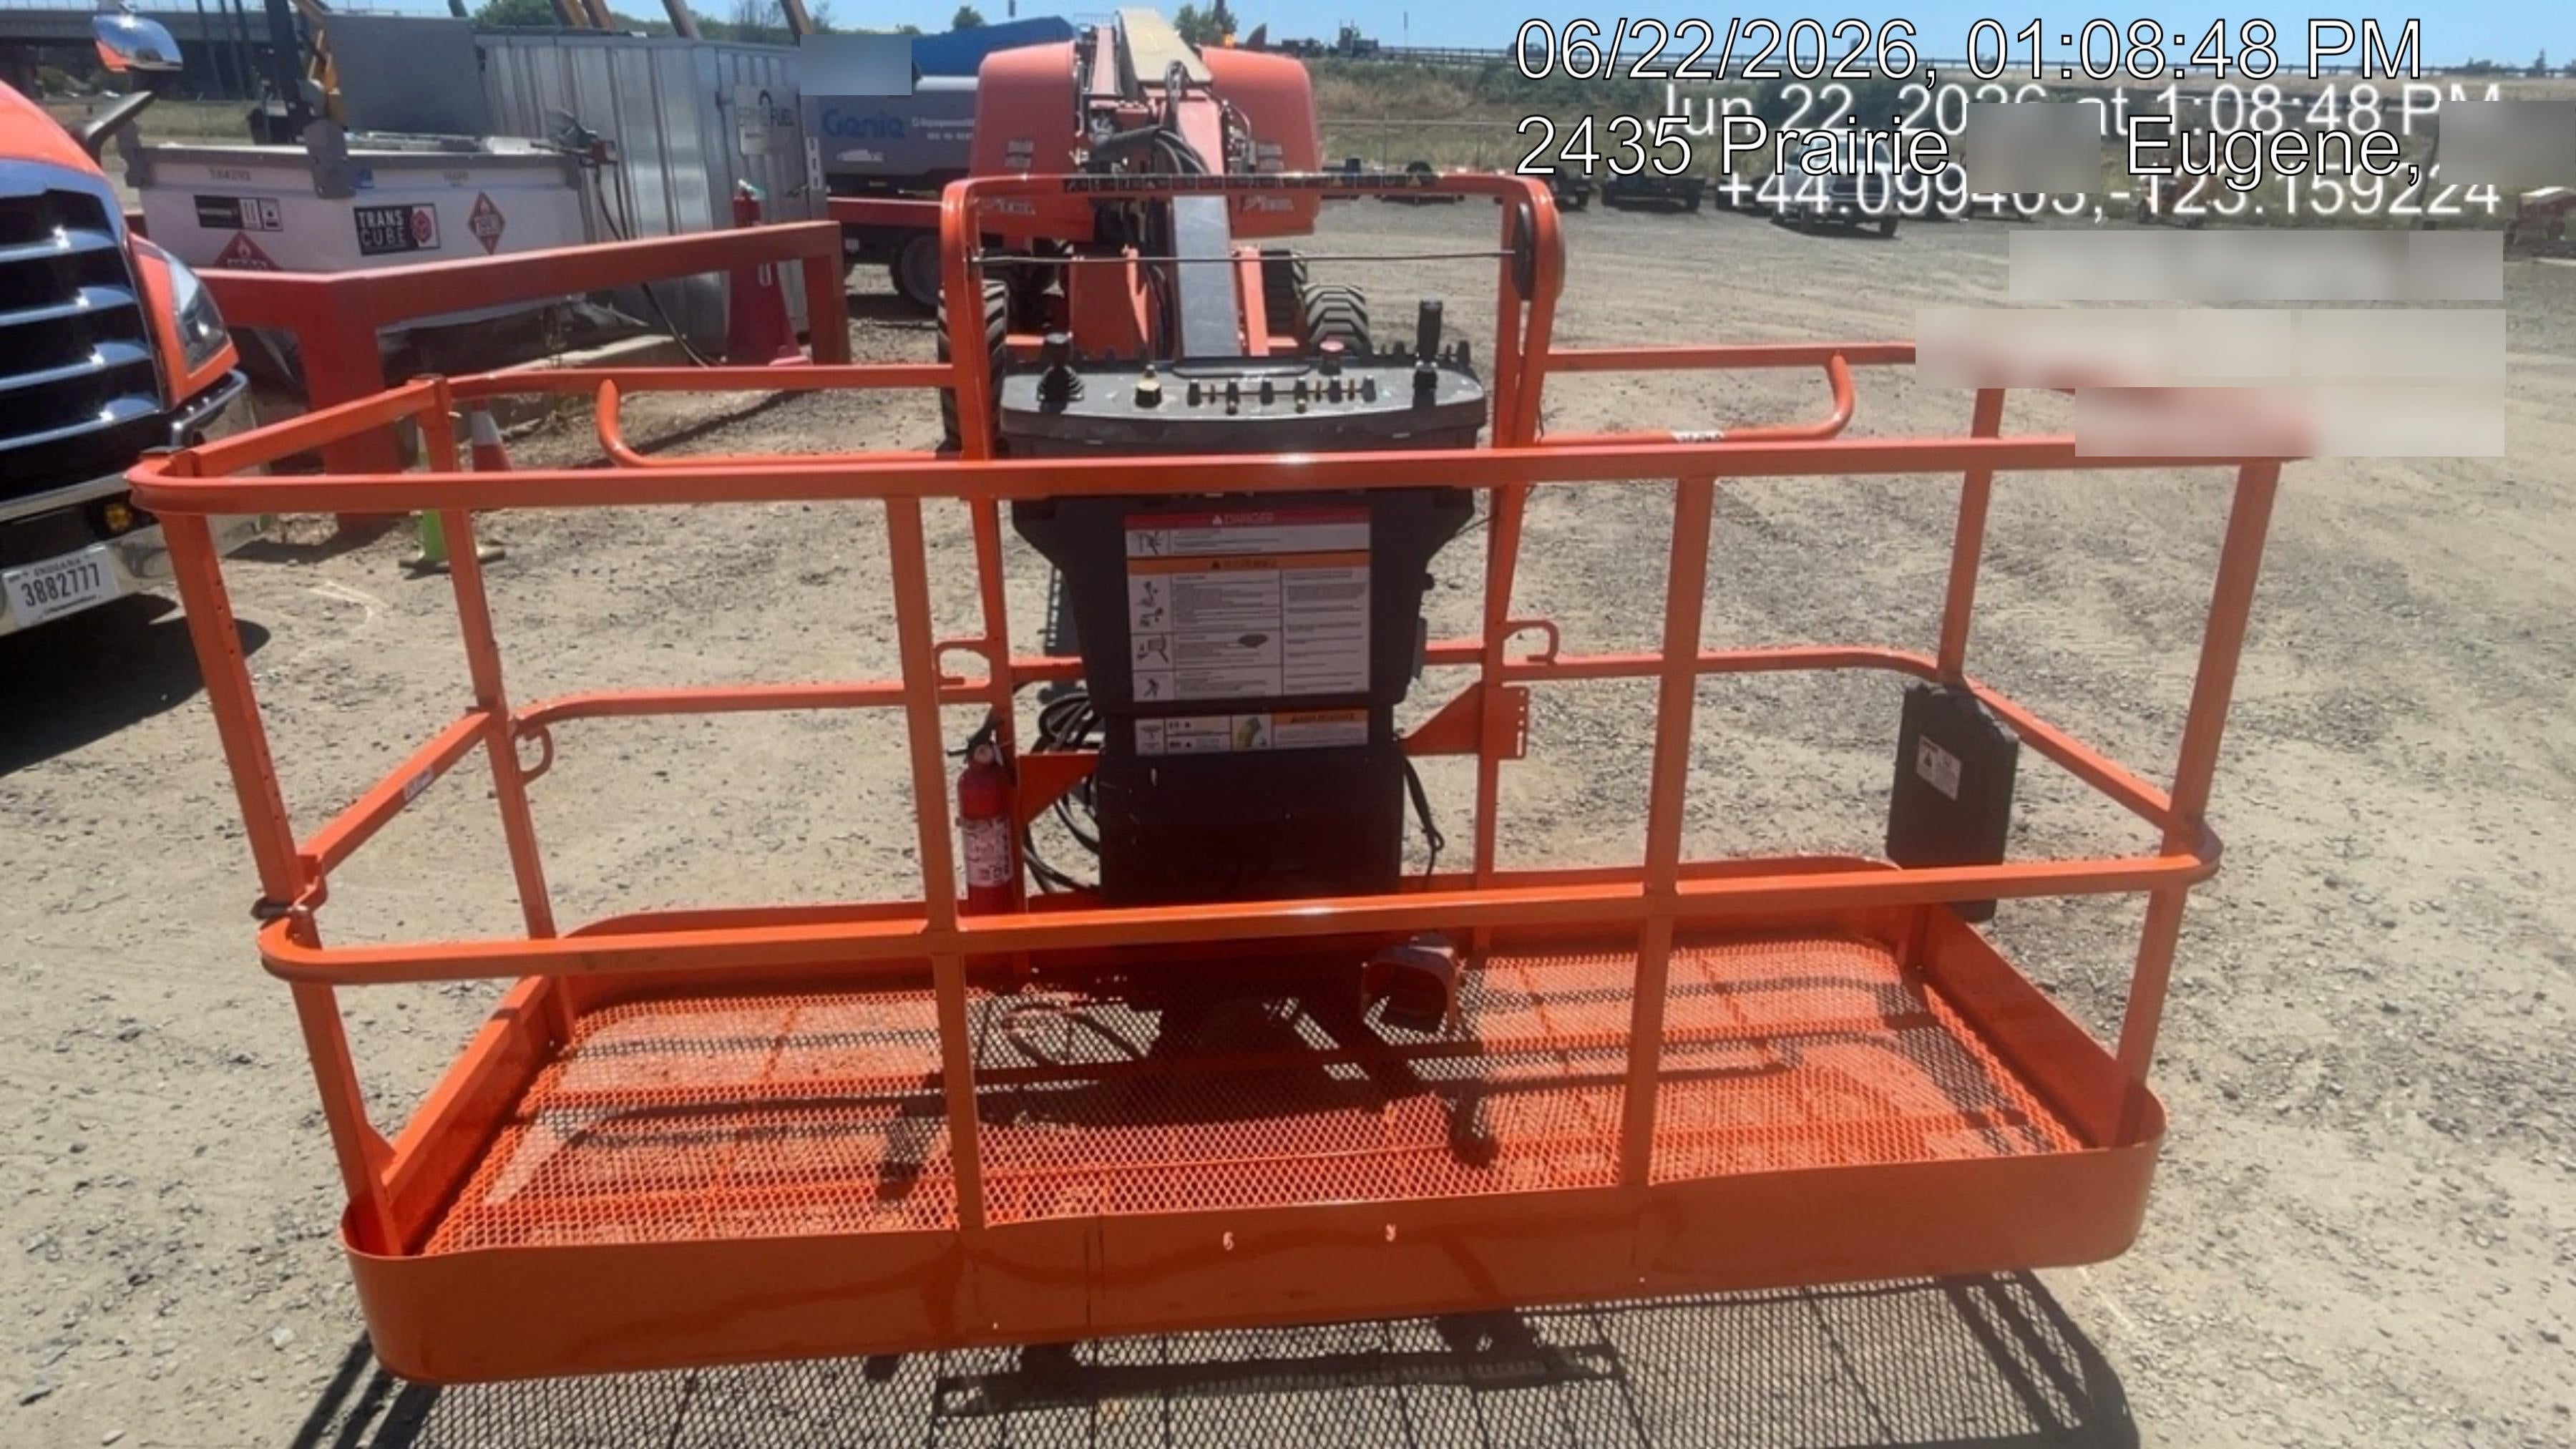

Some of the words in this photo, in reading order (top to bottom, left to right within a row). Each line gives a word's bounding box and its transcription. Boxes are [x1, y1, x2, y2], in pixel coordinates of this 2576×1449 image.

[822, 108, 905, 139] Genie
[358, 210, 404, 228] TRANS
[361, 225, 406, 246] CUBE
[1224, 512, 1275, 525] DANGER
[21, 562, 100, 608] 3882777
